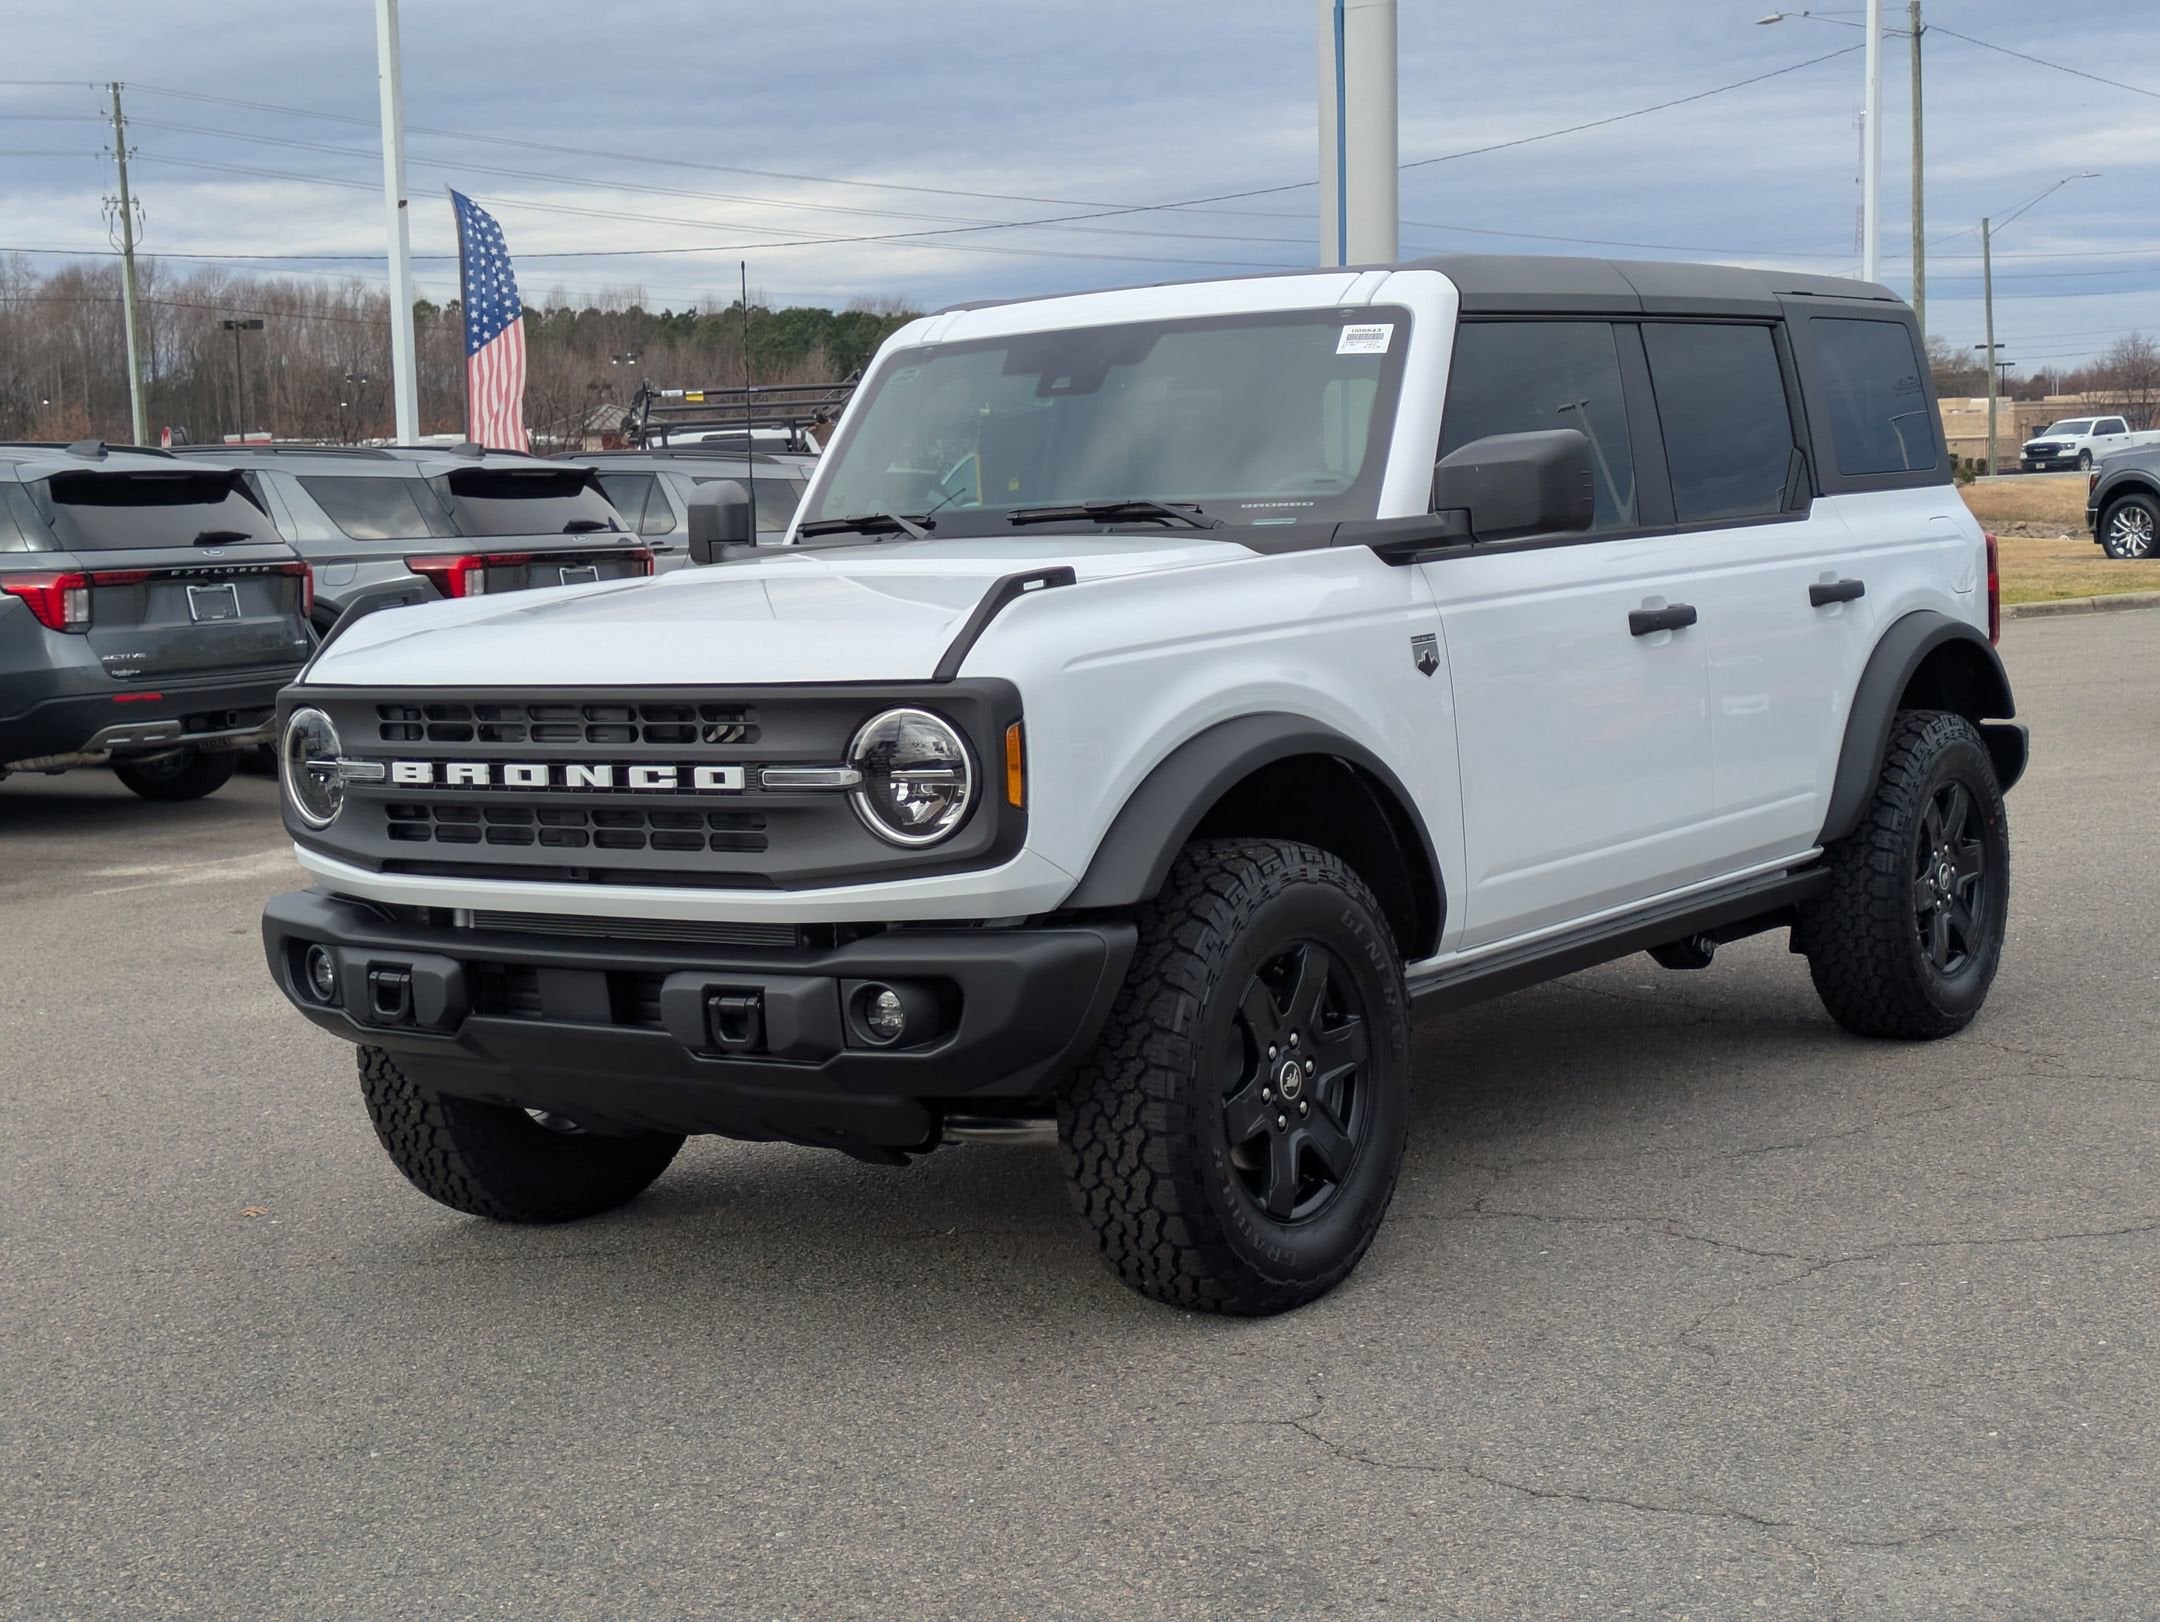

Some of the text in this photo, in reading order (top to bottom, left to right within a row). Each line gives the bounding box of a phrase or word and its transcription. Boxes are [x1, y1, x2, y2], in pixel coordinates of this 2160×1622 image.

[170, 566, 270, 576] EXPLORER
[391, 762, 745, 789] BRONCO
[1341, 908, 1403, 1051] GENERAL
